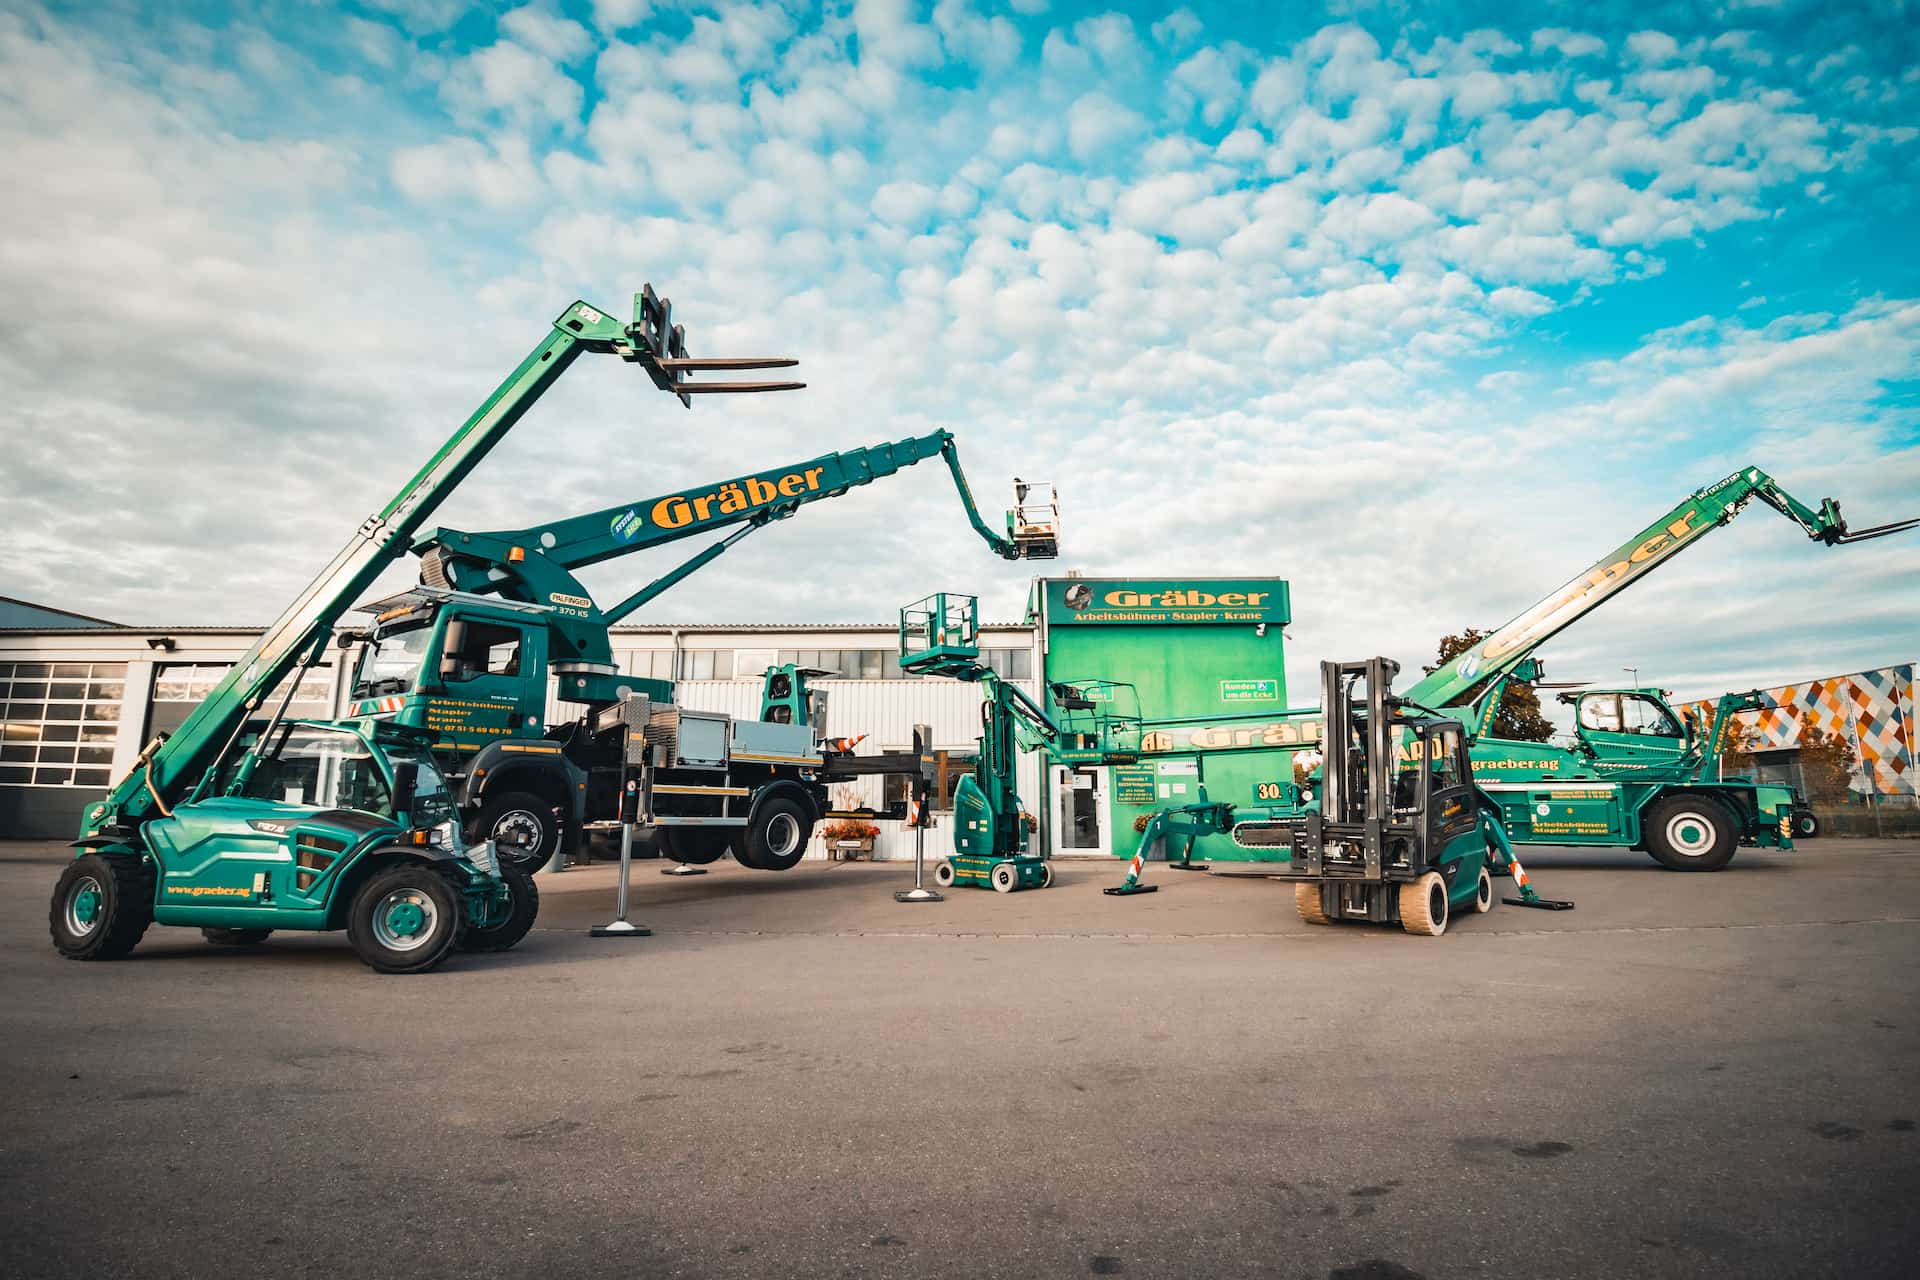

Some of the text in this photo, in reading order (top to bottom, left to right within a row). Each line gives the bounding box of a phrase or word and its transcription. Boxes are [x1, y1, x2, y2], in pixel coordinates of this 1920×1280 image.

[651, 466, 824, 529] Gräber
[1104, 590, 1269, 606] Gräber
[559, 607, 576, 616] 370
[577, 609, 589, 618] KS
[1074, 612, 1262, 621] Arbeitsbühnen Stapler Krane
[430, 699, 515, 711] Arbeitsbühnen
[428, 708, 473, 717] Stapler
[167, 886, 251, 897] www.graeber.ag
